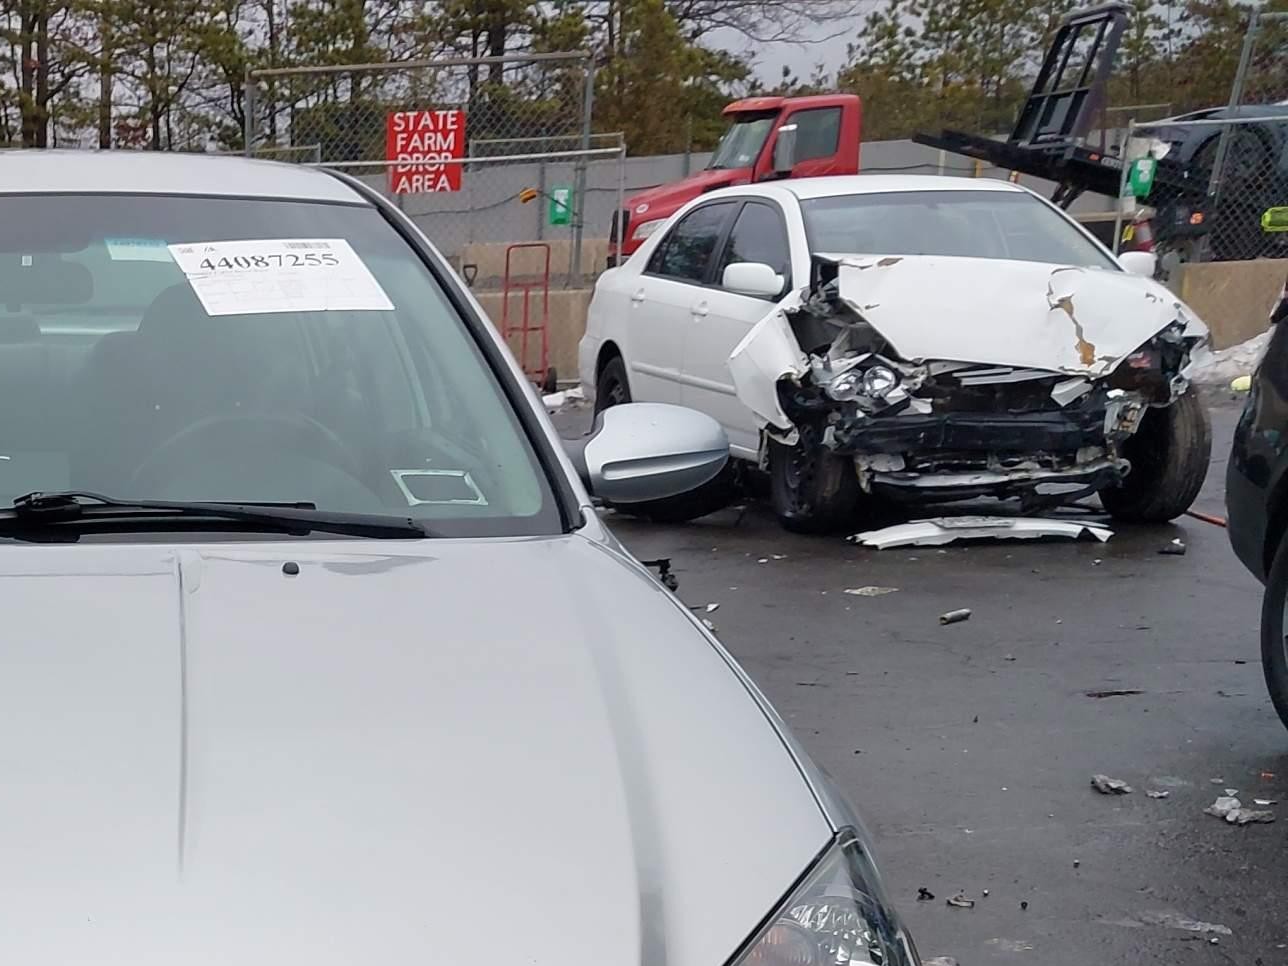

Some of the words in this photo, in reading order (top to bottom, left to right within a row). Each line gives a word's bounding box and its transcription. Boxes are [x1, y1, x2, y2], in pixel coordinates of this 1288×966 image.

[393, 110, 459, 131] STATE
[396, 131, 456, 153] FARM
[397, 152, 453, 172] DROP
[395, 173, 452, 194] AREA
[199, 252, 341, 271] 44087255
